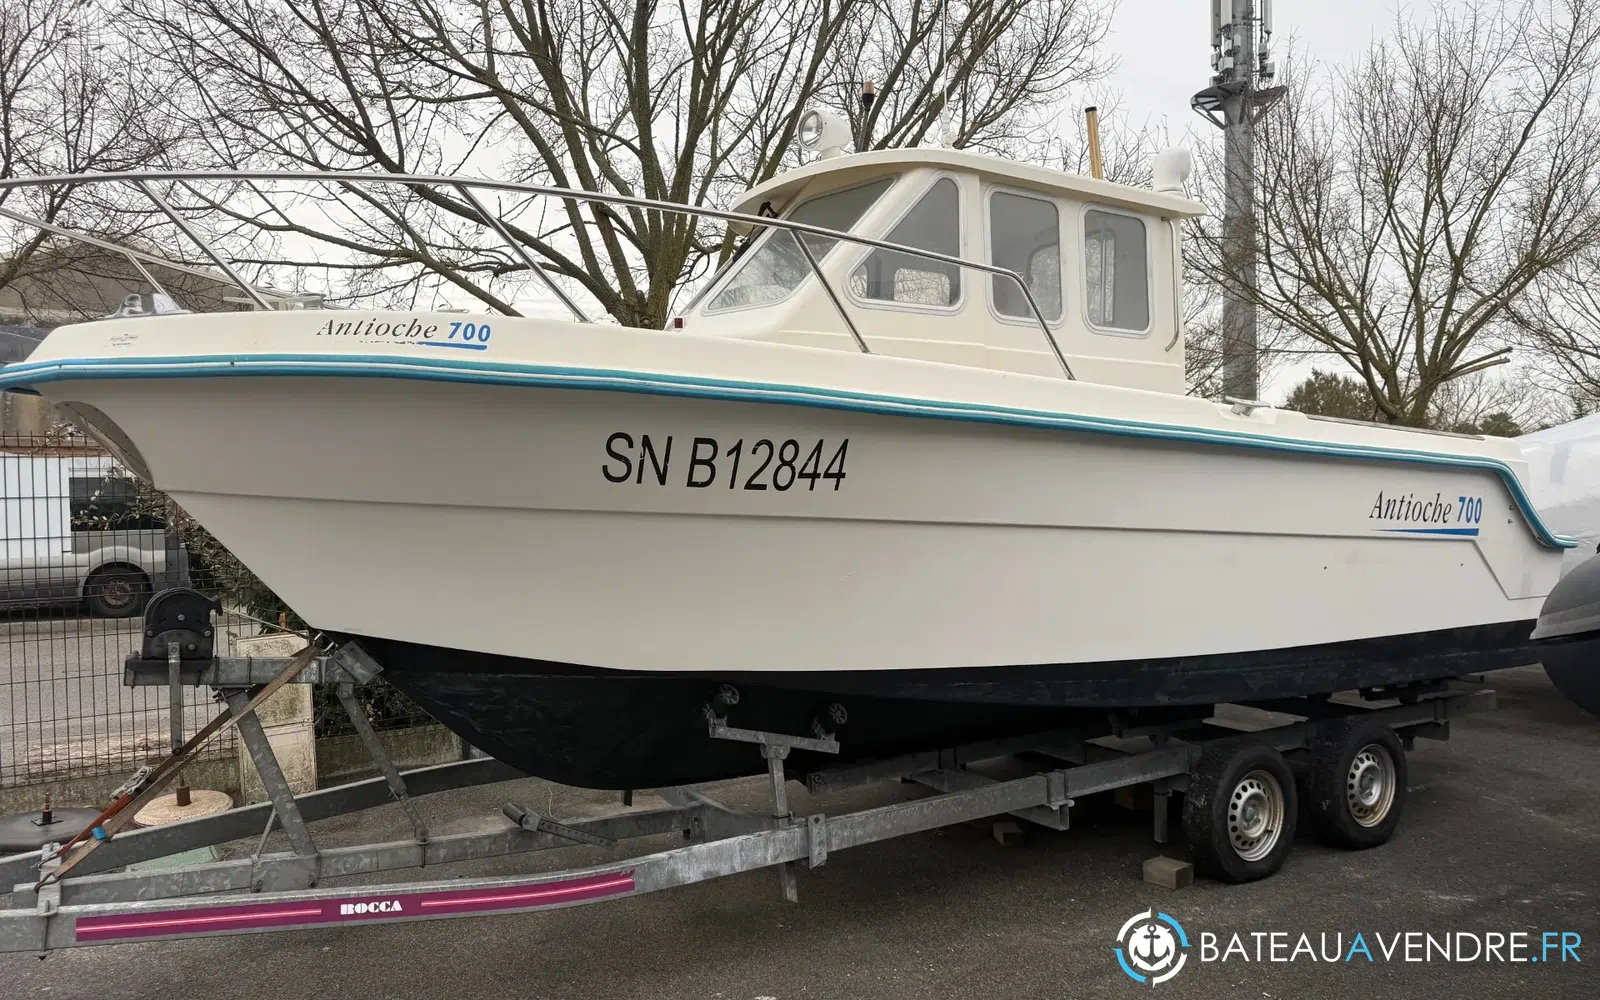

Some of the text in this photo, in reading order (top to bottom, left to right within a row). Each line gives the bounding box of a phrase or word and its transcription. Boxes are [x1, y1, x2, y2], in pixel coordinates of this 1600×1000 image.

[316, 317, 492, 343] Antioche 700
[602, 432, 850, 492] SN B12844
[1369, 490, 1483, 524] Antioche 700
[340, 900, 403, 915] ROCCA
